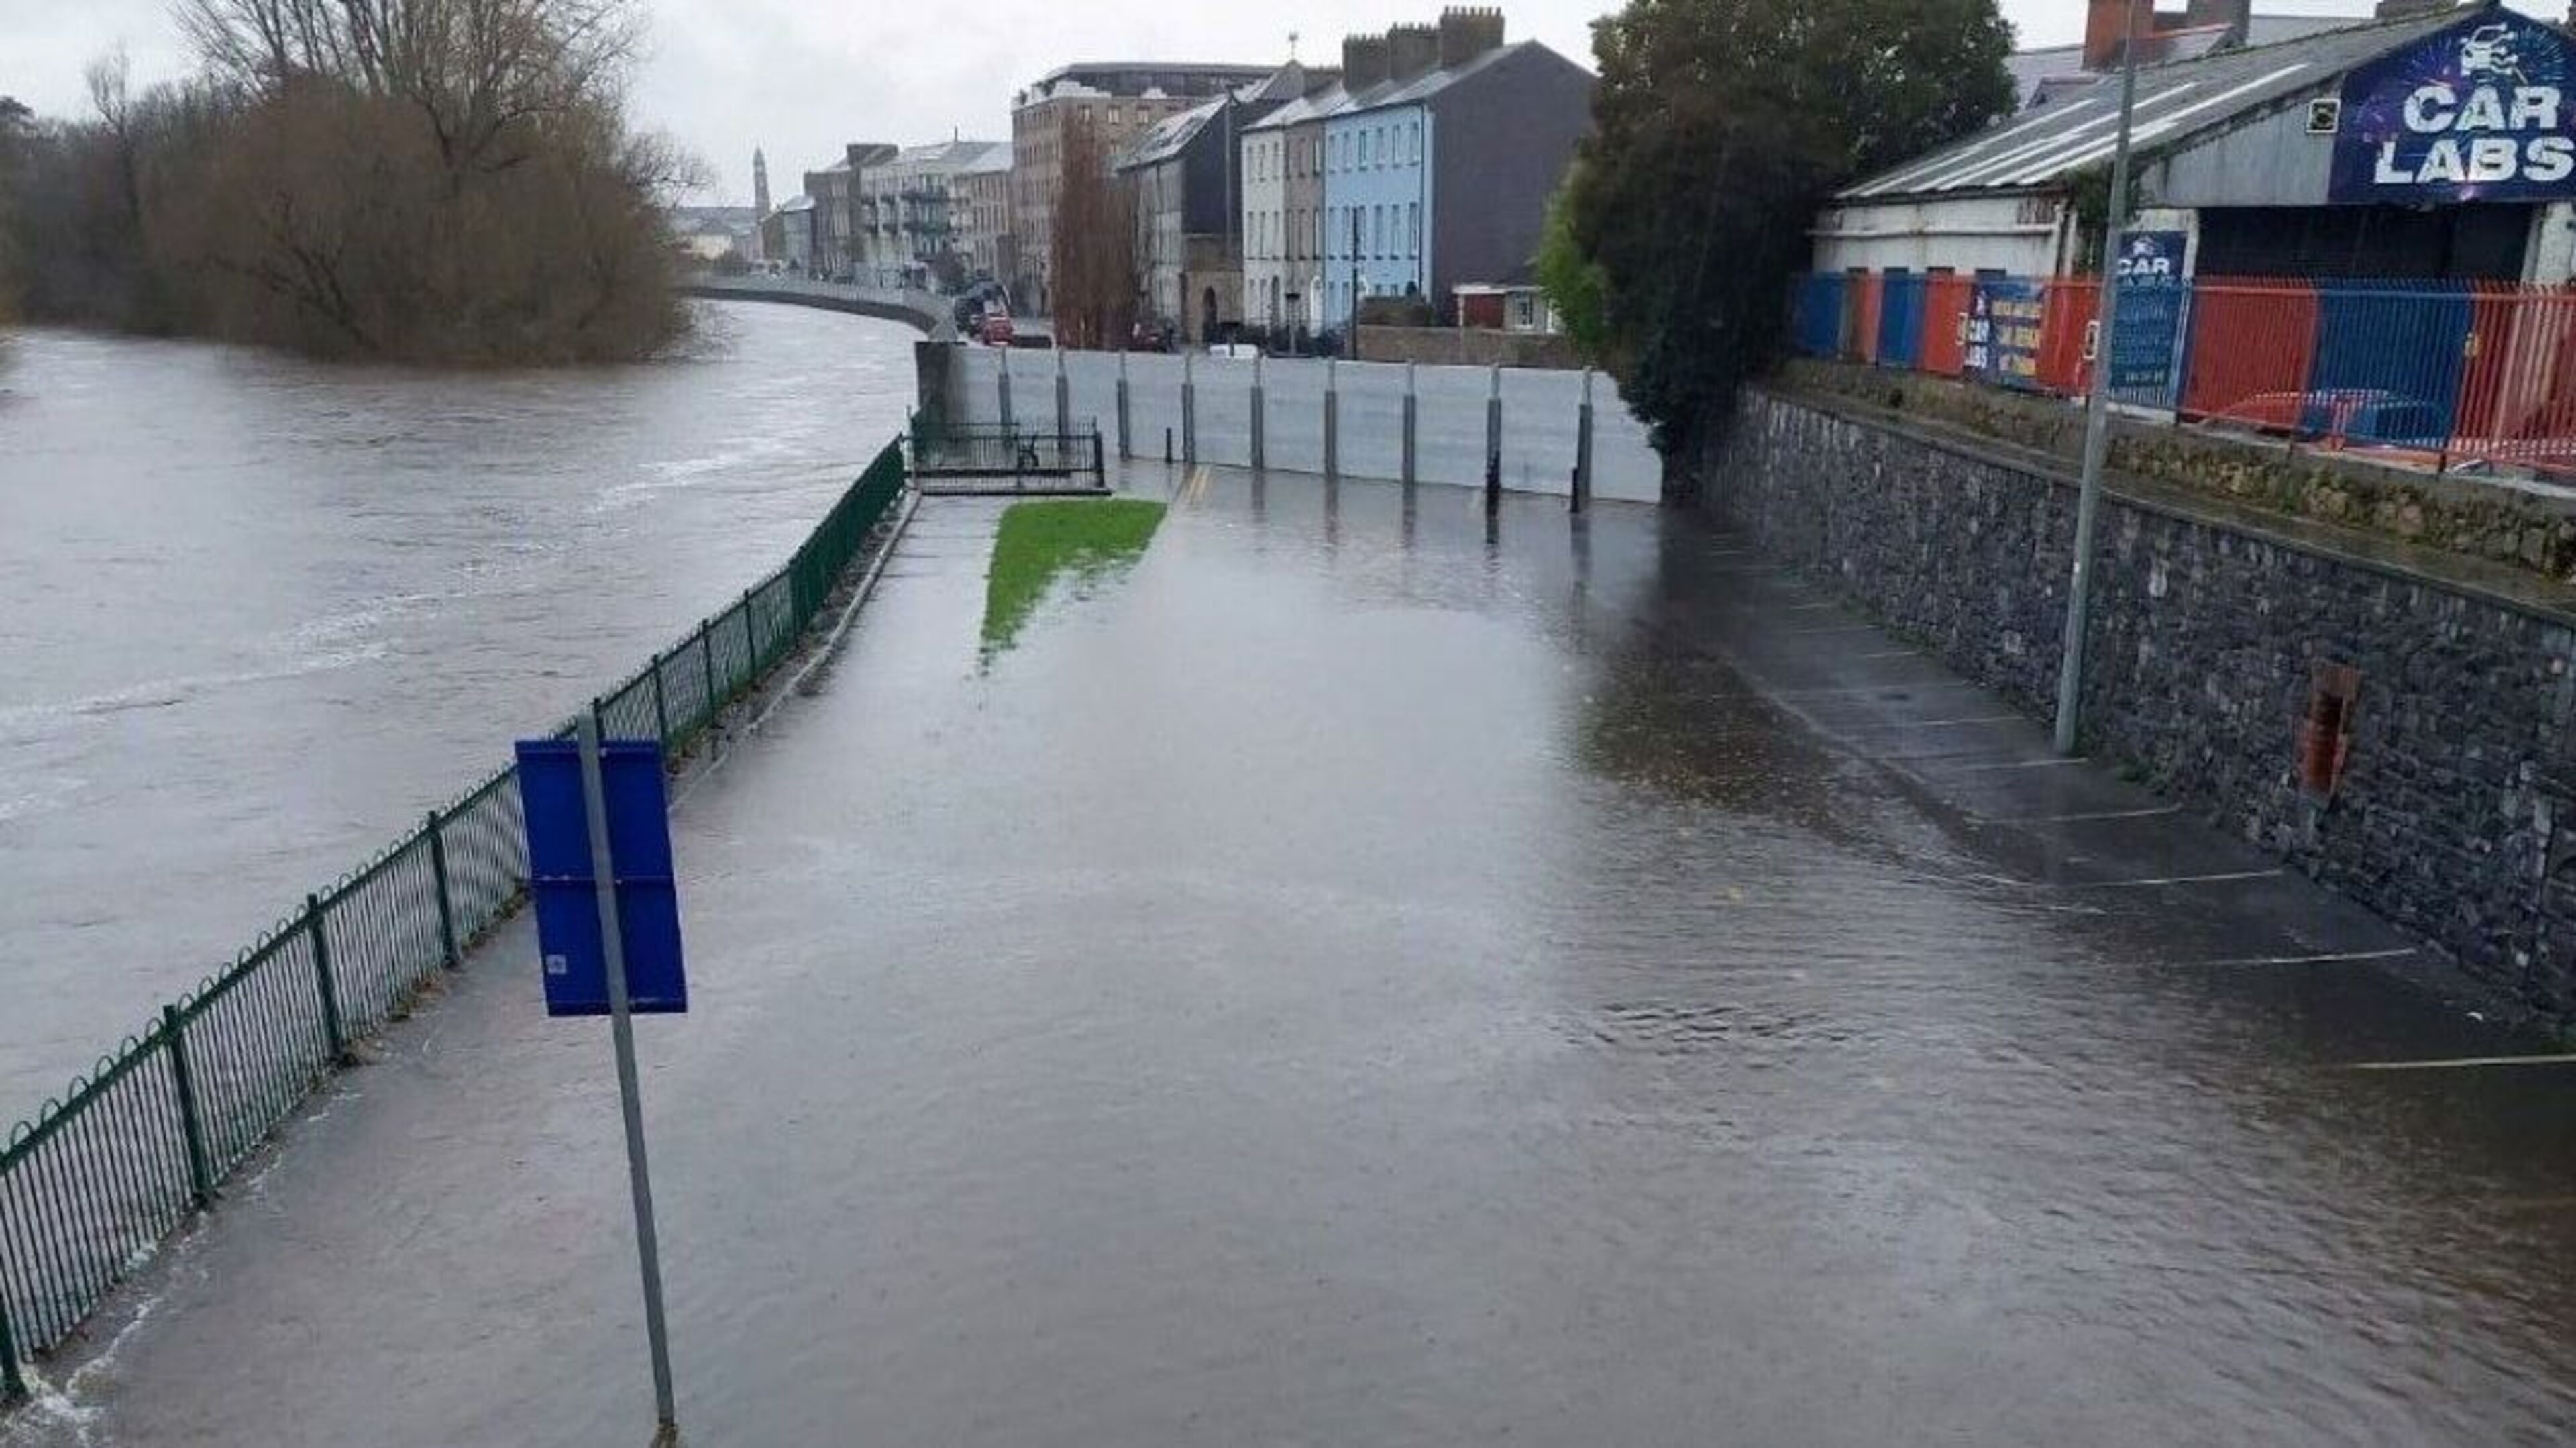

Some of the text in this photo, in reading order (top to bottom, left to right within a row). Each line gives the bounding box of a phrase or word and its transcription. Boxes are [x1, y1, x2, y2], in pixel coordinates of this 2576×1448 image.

[2404, 85, 2561, 133] CAR
[2375, 136, 2575, 183] LABS
[2118, 257, 2170, 276] CAR
